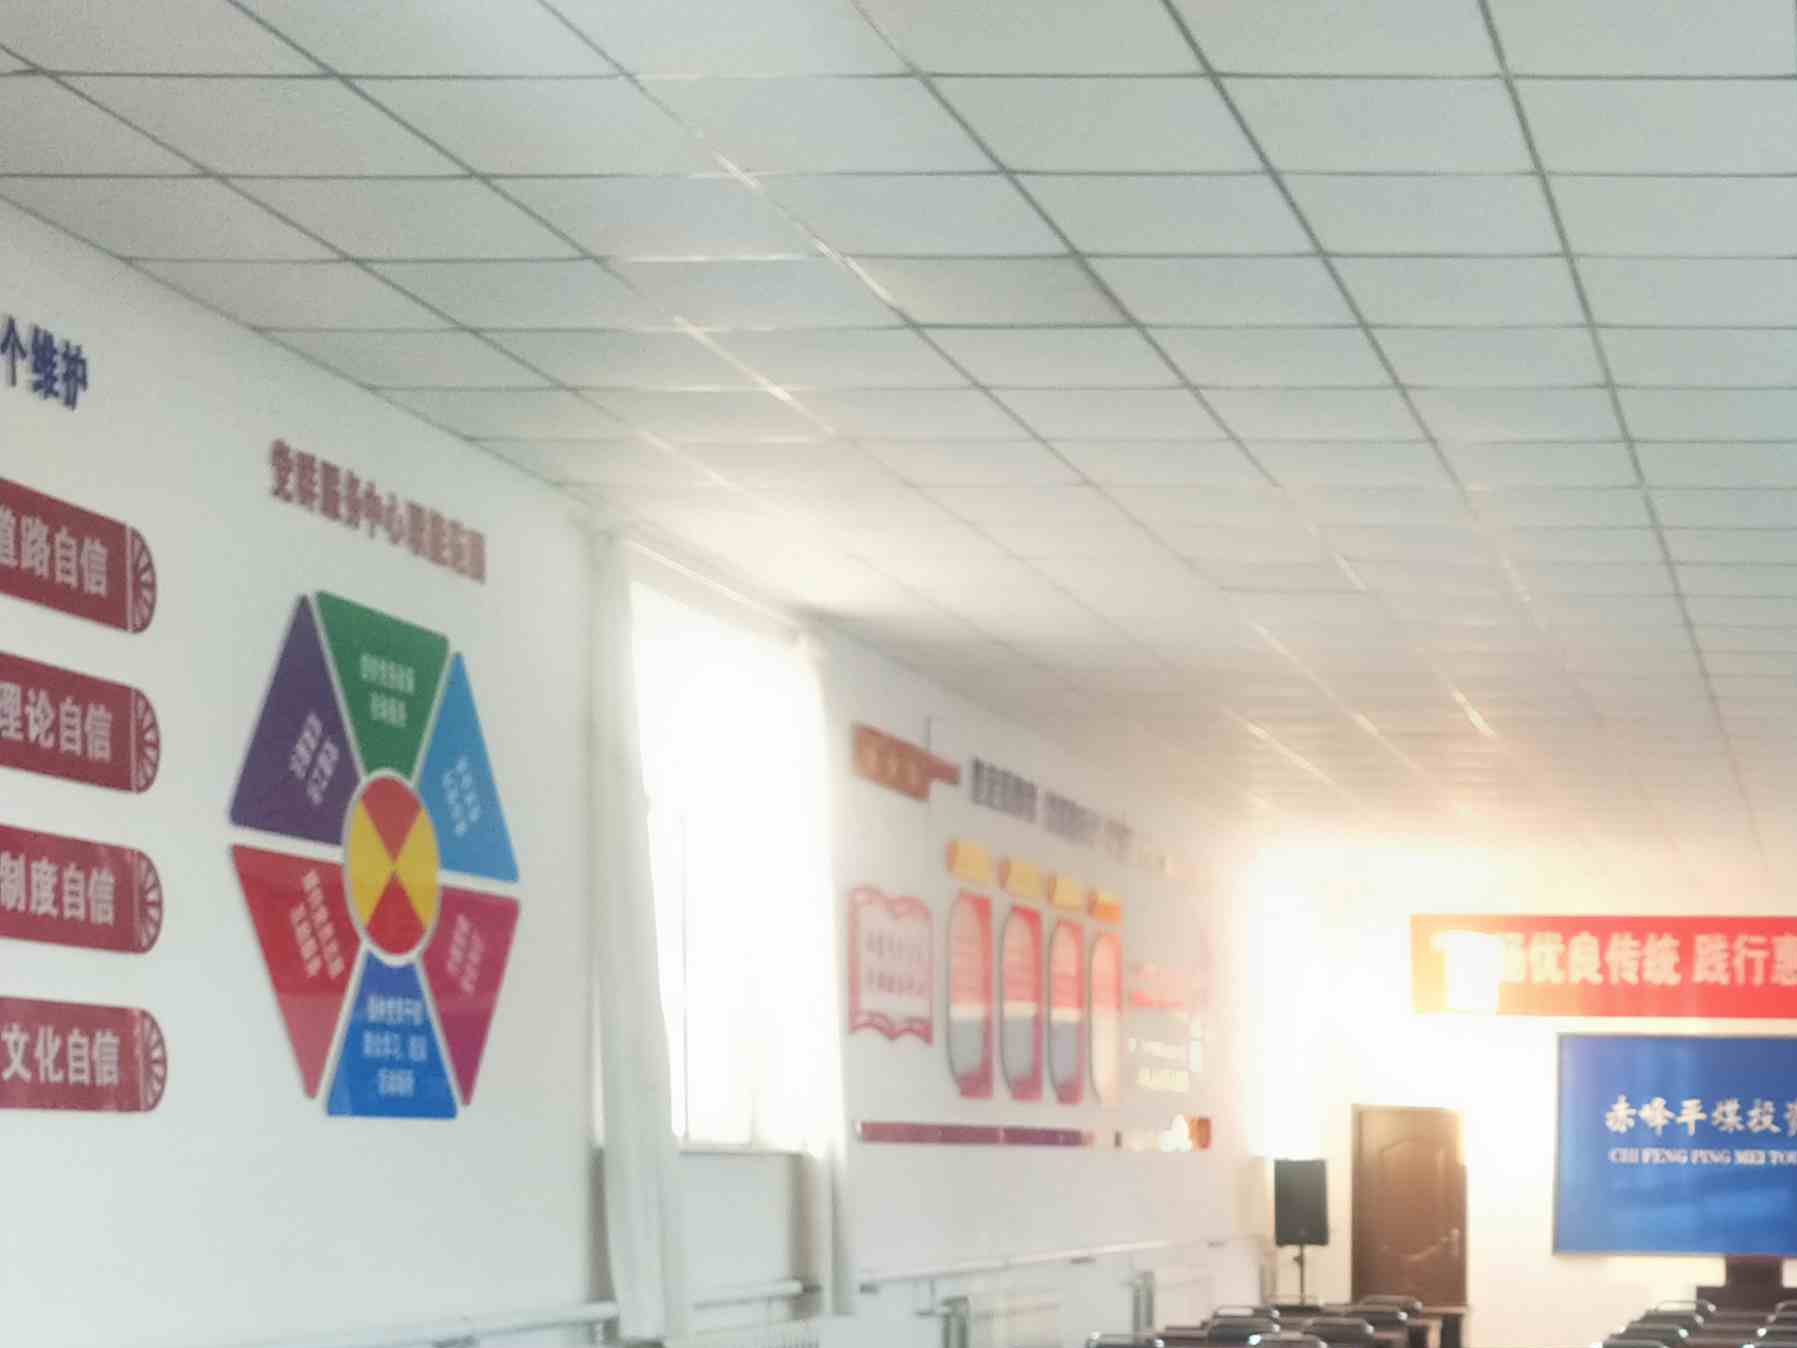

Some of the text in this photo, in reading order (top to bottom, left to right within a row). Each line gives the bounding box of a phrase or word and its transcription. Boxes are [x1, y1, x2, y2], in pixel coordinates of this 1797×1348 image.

[0, 316, 89, 411] 个维护
[0, 684, 113, 762] 理论自信
[0, 851, 117, 928] 制度自信
[2, 1023, 121, 1087] 文化自信
